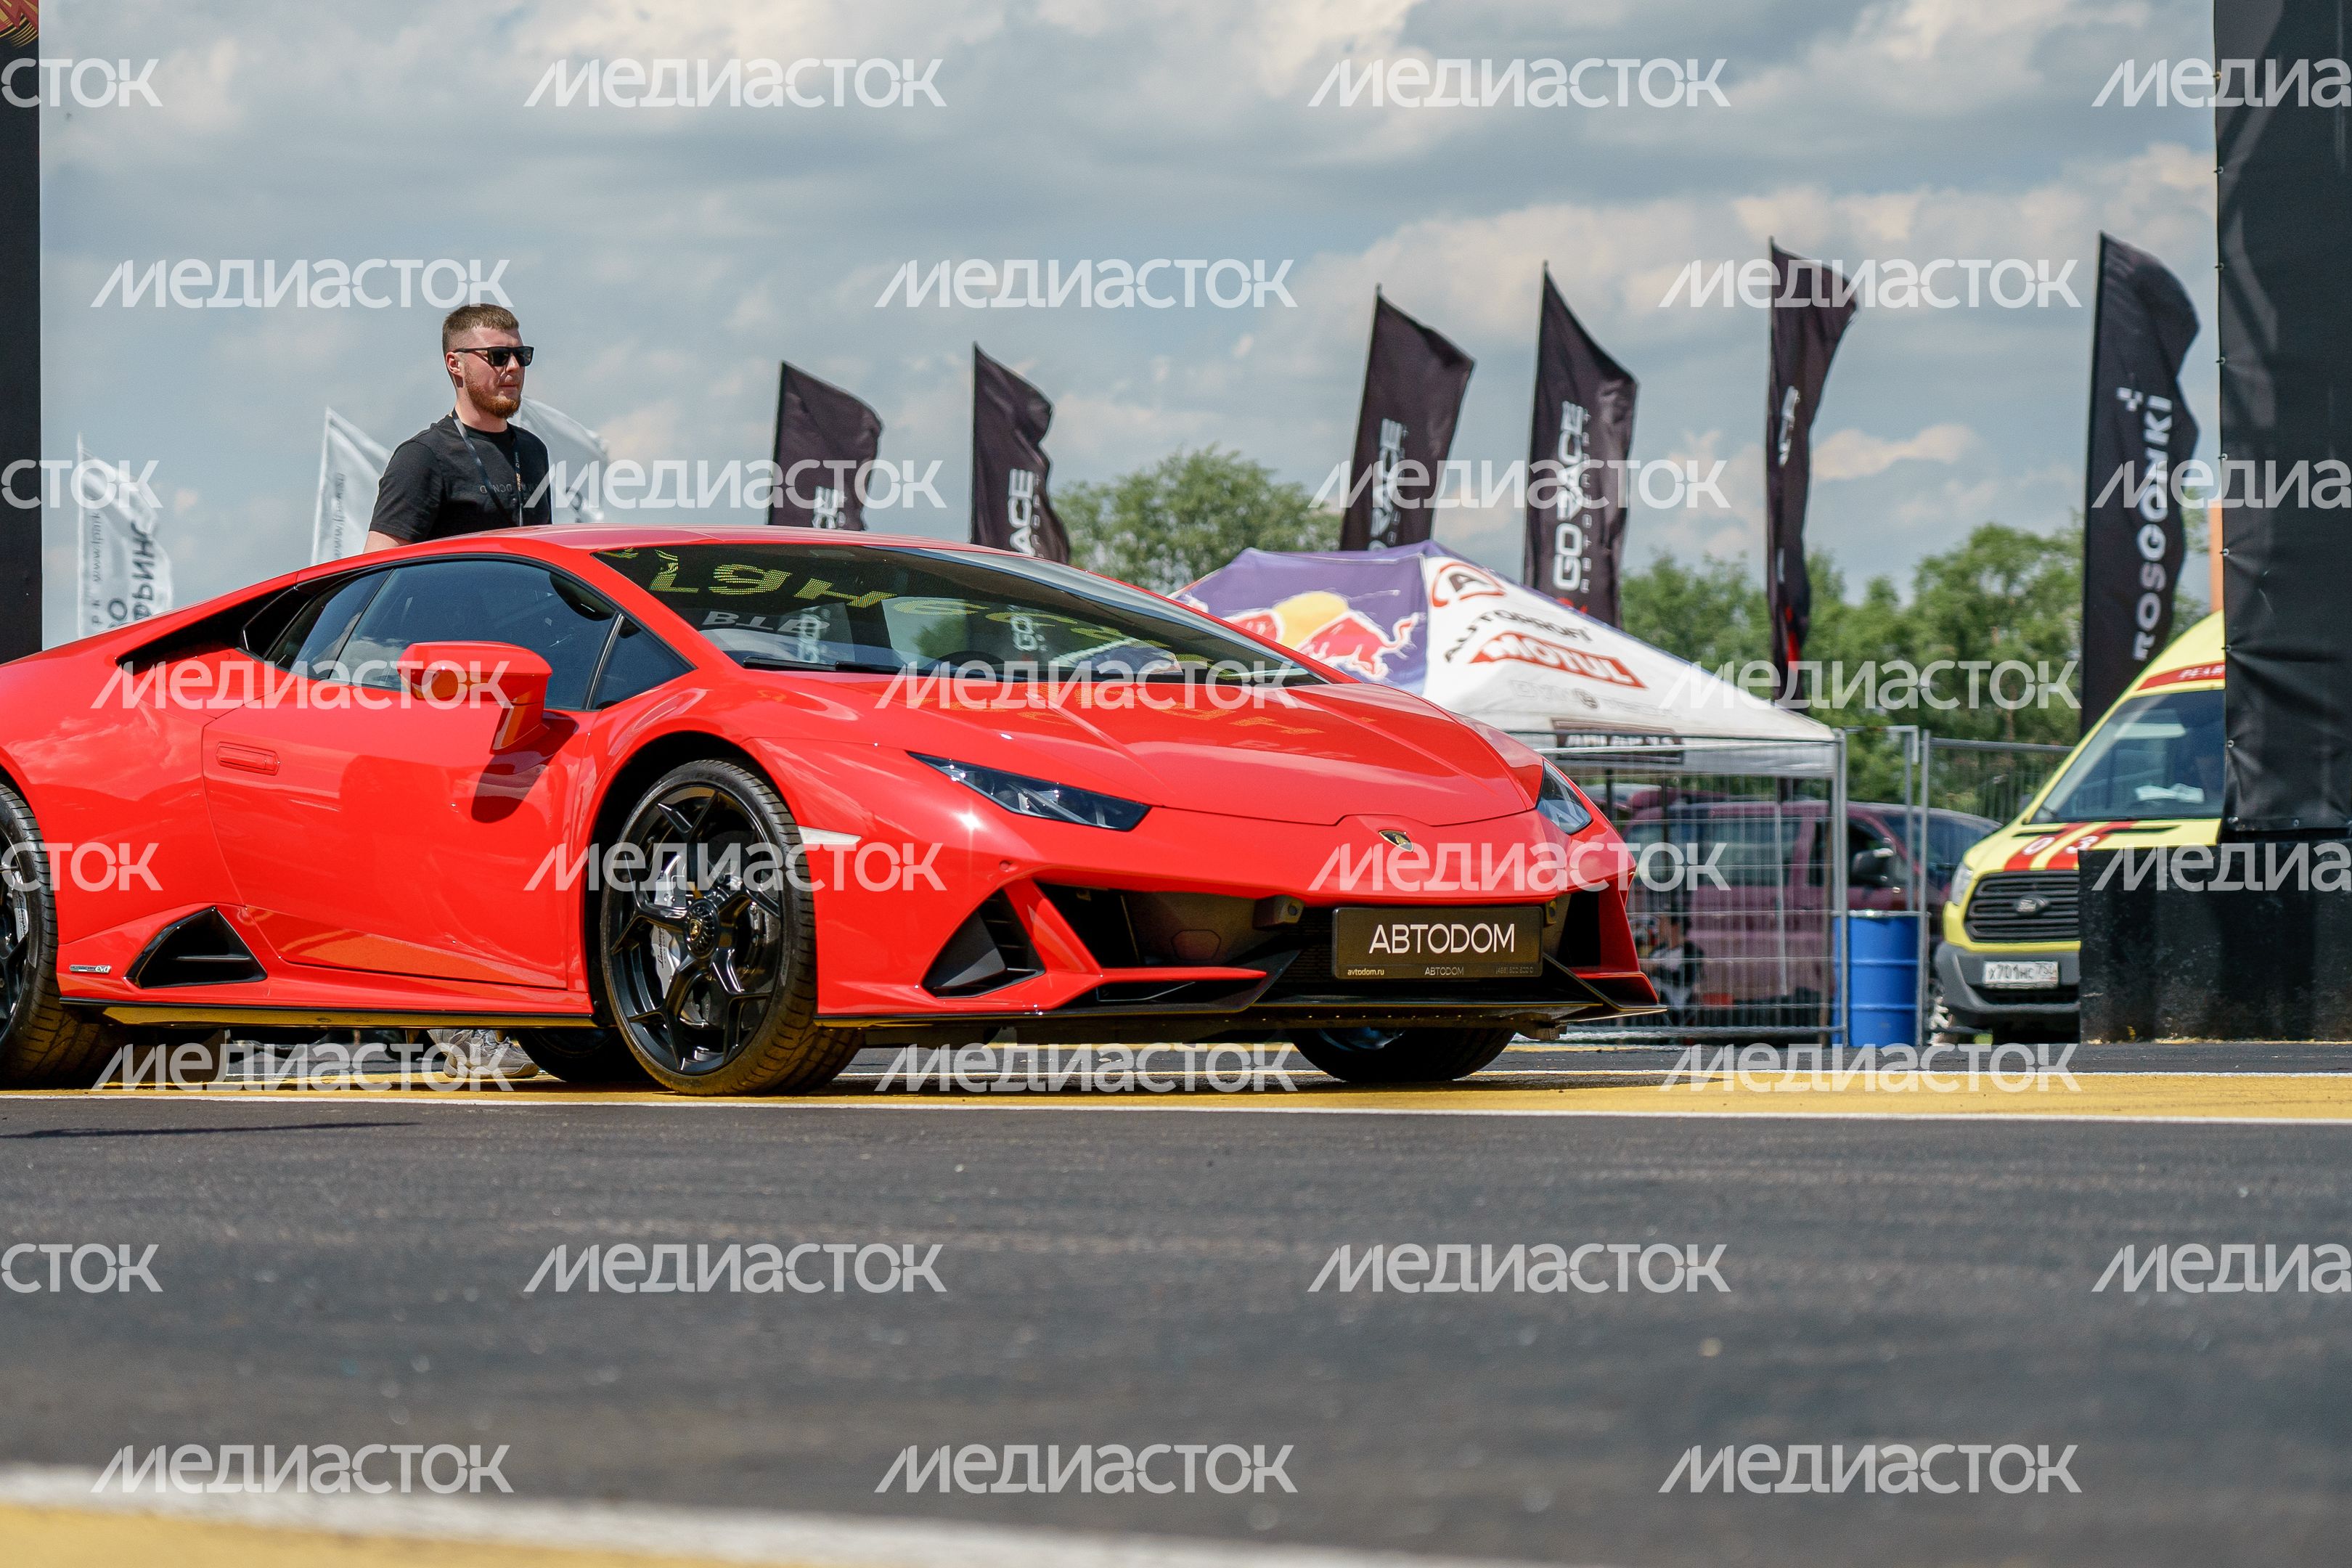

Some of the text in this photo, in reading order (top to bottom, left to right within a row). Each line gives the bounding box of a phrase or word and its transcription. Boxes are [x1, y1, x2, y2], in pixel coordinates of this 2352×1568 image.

[1008, 468, 1036, 557] ACE
[2132, 395, 2173, 662] ROSGONKI
[1445, 609, 1593, 662] AUTOPROFI
[1482, 634, 1636, 686] MOTUL
[1347, 968, 1385, 976] avtodom.ru
